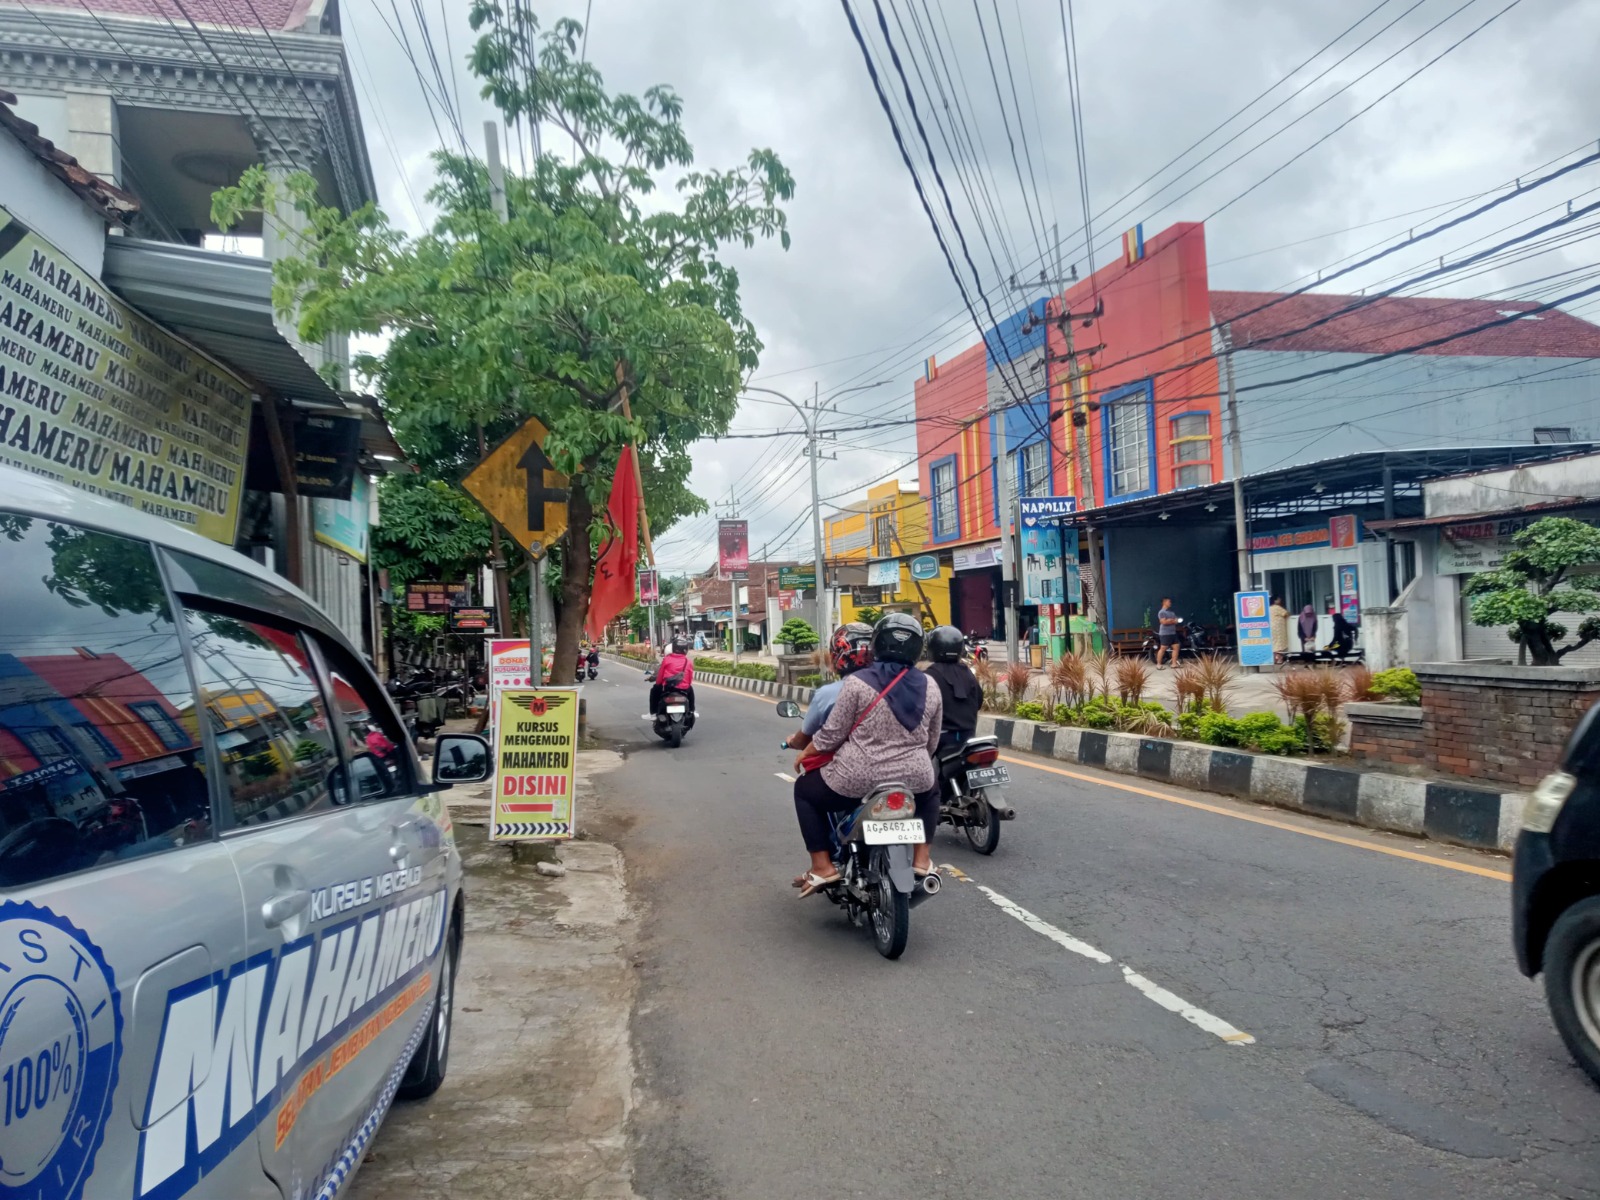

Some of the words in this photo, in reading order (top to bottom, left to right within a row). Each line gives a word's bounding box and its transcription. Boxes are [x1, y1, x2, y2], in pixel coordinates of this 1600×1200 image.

[29, 249, 124, 330] MAHAMERU
[0, 300, 100, 371] AHAMERU
[1, 269, 73, 324] MAHAMERU
[76, 317, 132, 361] MAHAMERU
[40, 358, 108, 402] MAHAMERU
[71, 402, 163, 457] MAHAMERU
[166, 443, 237, 487] MAHAMERU
[109, 451, 228, 515] MAHAMERU
[141, 499, 198, 524] MAHAMERU
[1021, 502, 1072, 513] NAPOLLY
[1277, 532, 1293, 547] ICE
[1294, 528, 1330, 545] CREAM
[499, 657, 528, 665] DONAT
[504, 735, 570, 746] MENGEMUDI
[517, 722, 559, 733] KURSUS
[502, 752, 569, 769] MAHAMERU
[503, 775, 567, 796] DISINI
[310, 877, 373, 922] KURSUS
[140, 890, 448, 1197] MAHAMERU
[3, 1034, 72, 1127] 100%
